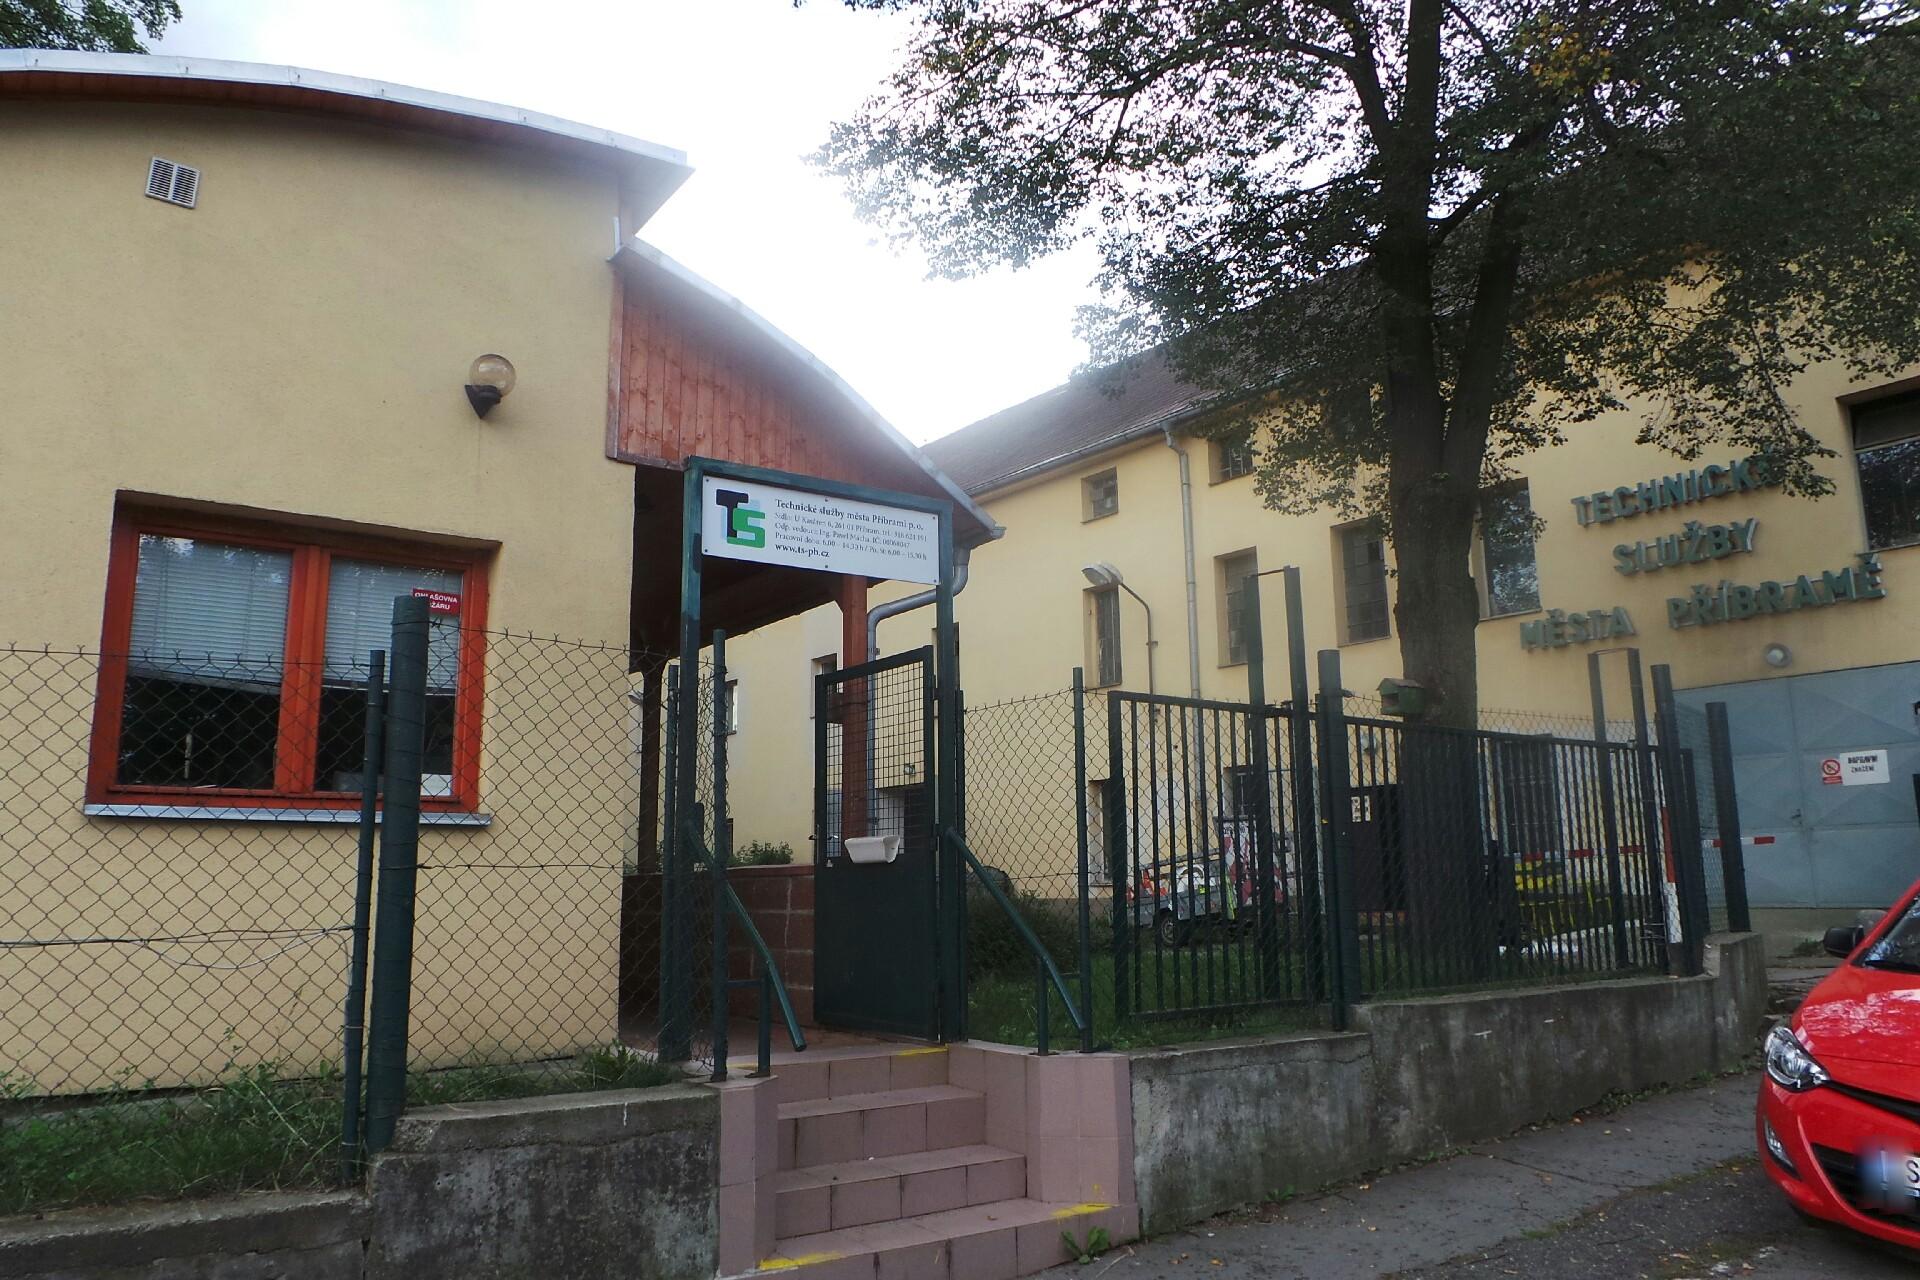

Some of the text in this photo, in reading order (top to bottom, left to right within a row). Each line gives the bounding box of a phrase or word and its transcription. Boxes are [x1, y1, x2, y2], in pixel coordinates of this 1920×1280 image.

[716, 489, 765, 548] TS
[775, 498, 817, 514] Technické
[819, 506, 845, 520] služby
[847, 511, 870, 522] města
[908, 521, 916, 530] p.
[1612, 517, 1760, 576] SLUŽBY
[414, 592, 458, 603] OHAŠOVNA
[1519, 552, 1888, 651] MĚSTA PŘÍBRAMĚ
